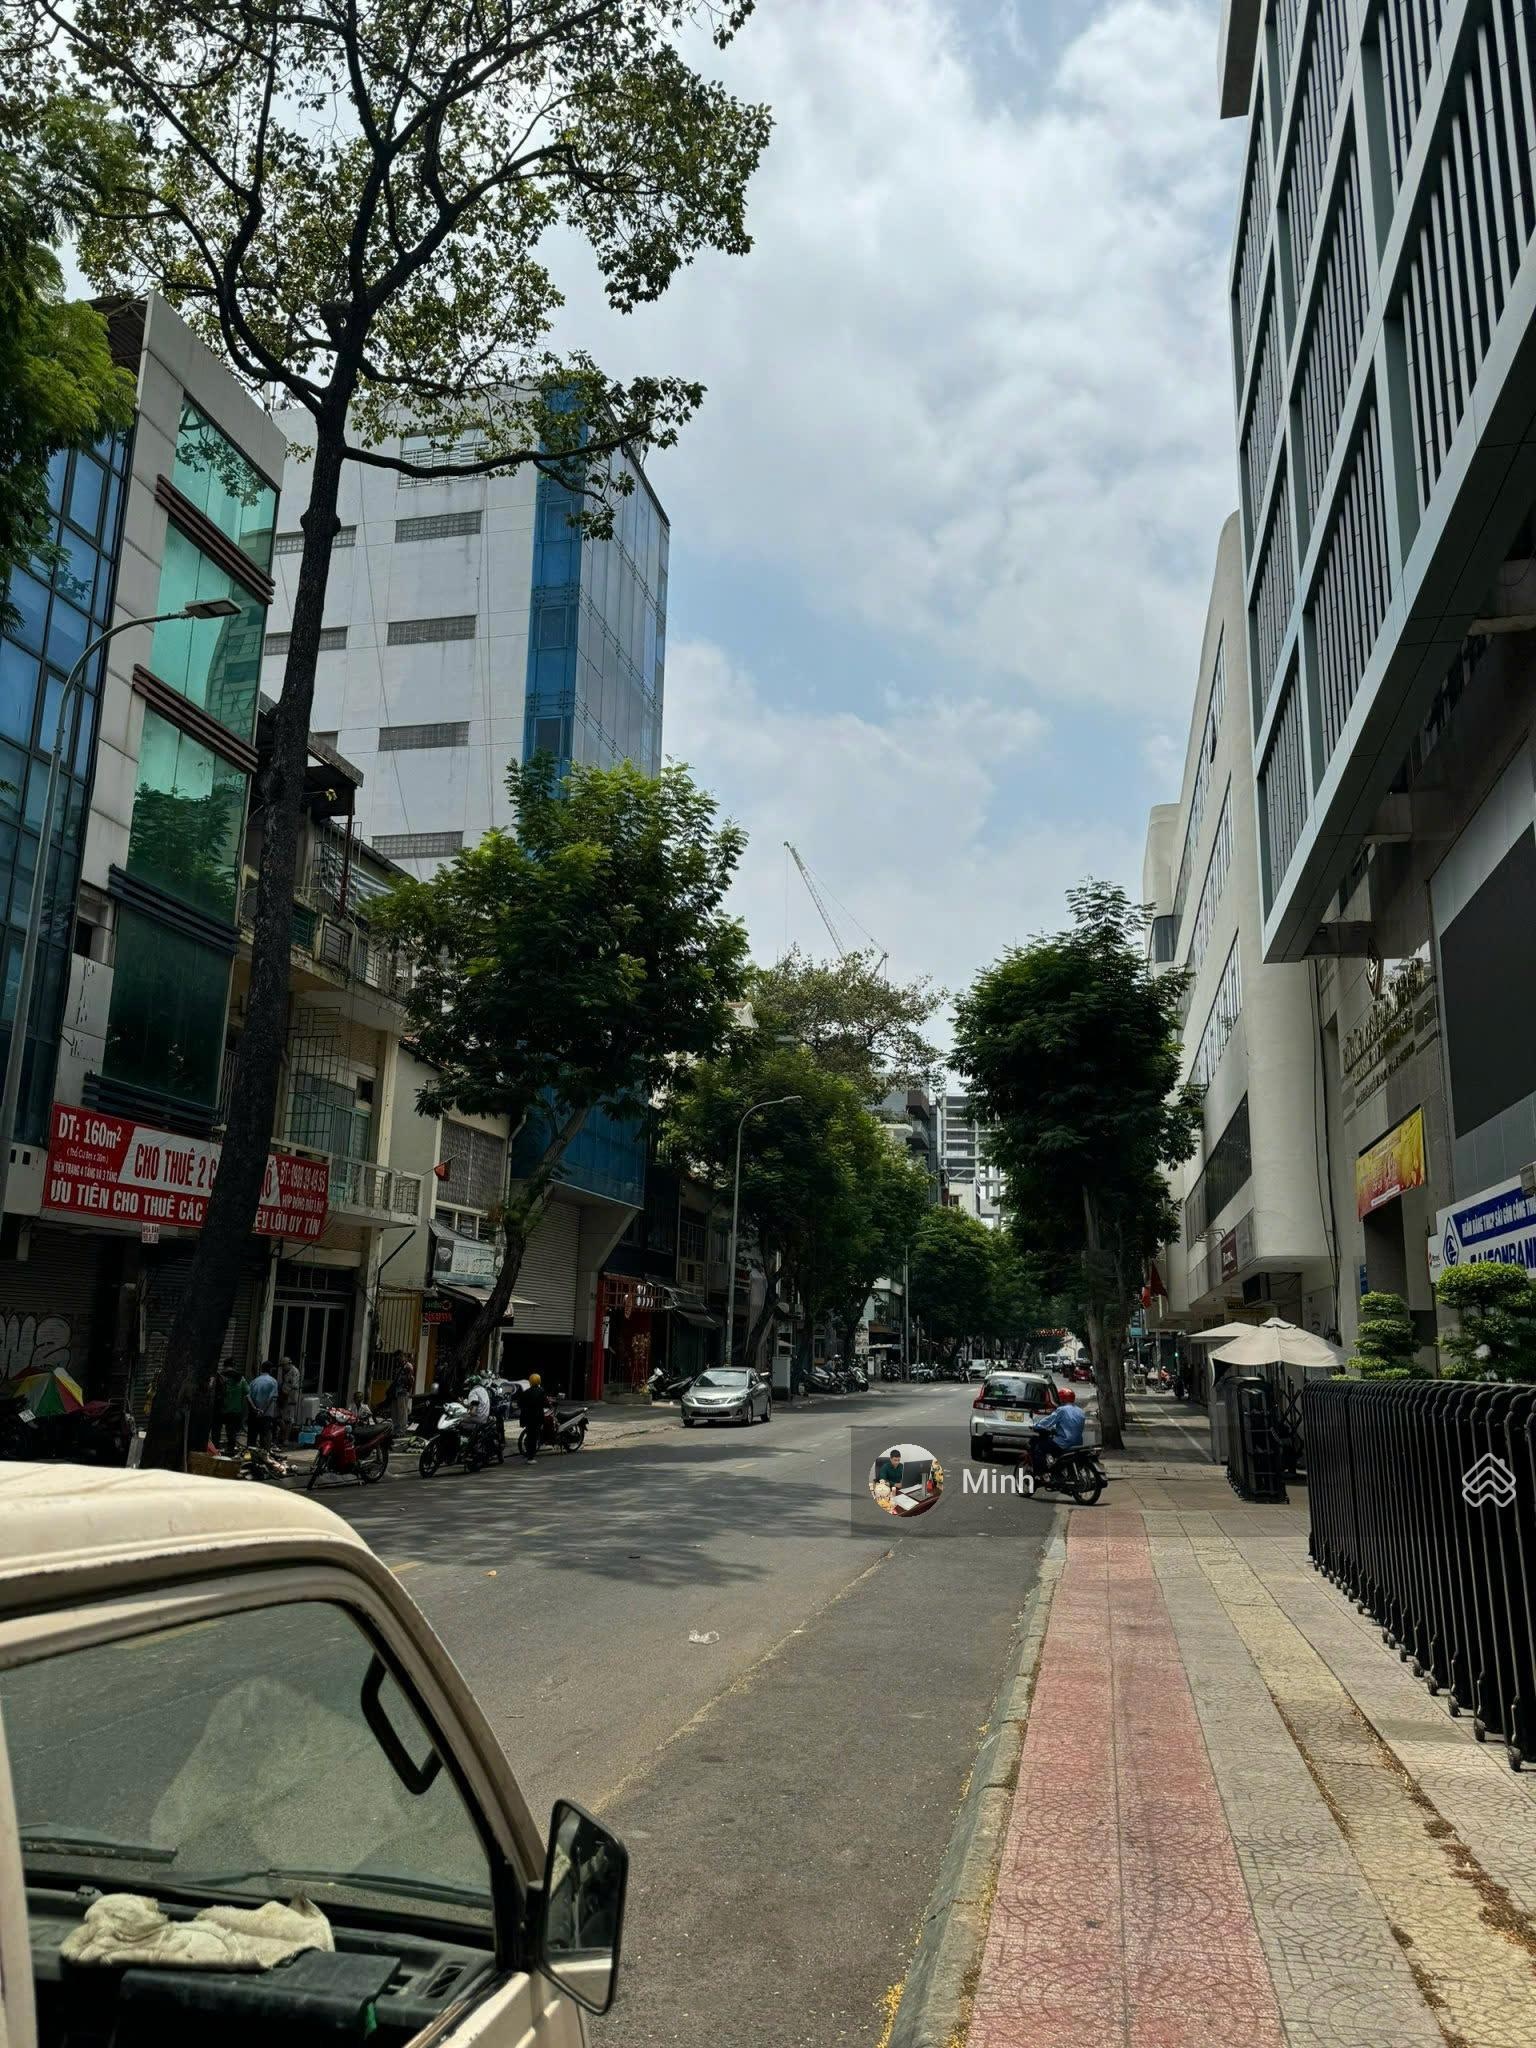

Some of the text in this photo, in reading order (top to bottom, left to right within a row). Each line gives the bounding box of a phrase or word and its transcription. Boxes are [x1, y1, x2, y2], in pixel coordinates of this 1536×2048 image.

[58, 1112, 80, 1142] DT:
[80, 1165, 84, 1177] 4
[102, 1169, 106, 1181] 3
[134, 1143, 160, 1180] CHO
[163, 1147, 196, 1187] THUÊ
[197, 1155, 207, 1188] 2
[50, 1177, 72, 1204] ƯU
[77, 1182, 110, 1210] TIÊN
[112, 1190, 139, 1214] CHO
[143, 1195, 176, 1219] THUÊ
[178, 1197, 203, 1222] CÁC
[270, 1209, 288, 1232] LỚN
[288, 1214, 303, 1233] UY
[304, 1214, 321, 1235] TÍN
